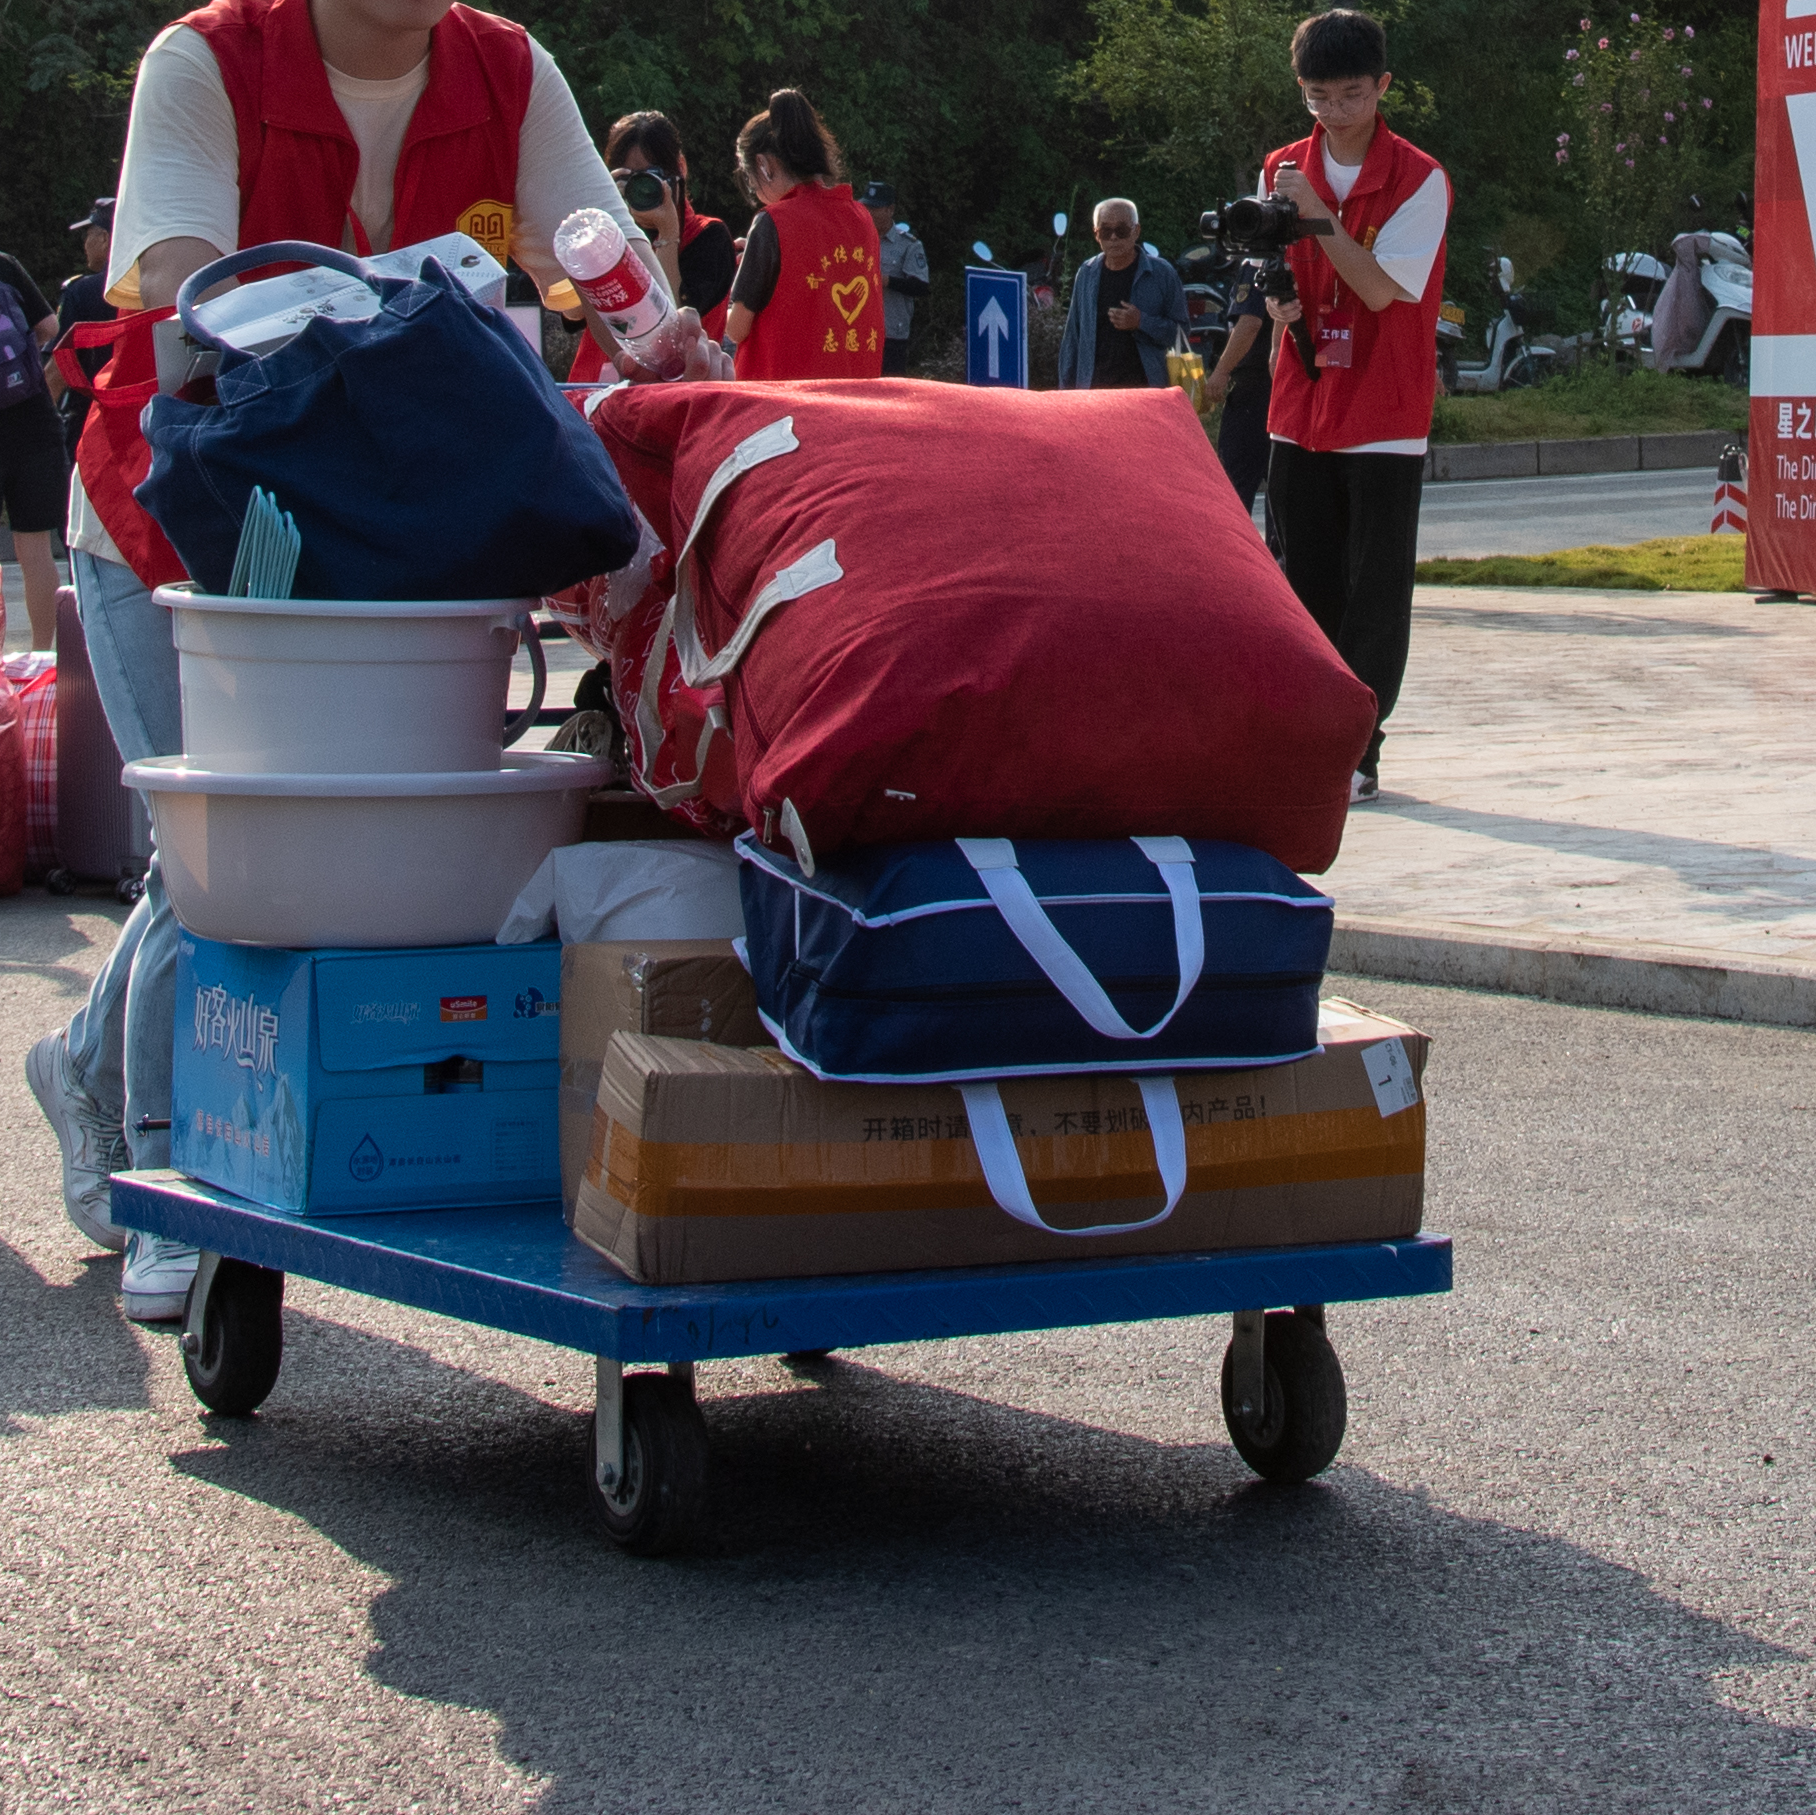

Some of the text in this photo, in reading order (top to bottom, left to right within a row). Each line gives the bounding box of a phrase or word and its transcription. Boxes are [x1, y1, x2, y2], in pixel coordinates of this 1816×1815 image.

[823, 328, 877, 352] 志愿者
[1321, 328, 1350, 340] 工作证
[1776, 454, 1797, 480] The
[1776, 493, 1796, 520] The
